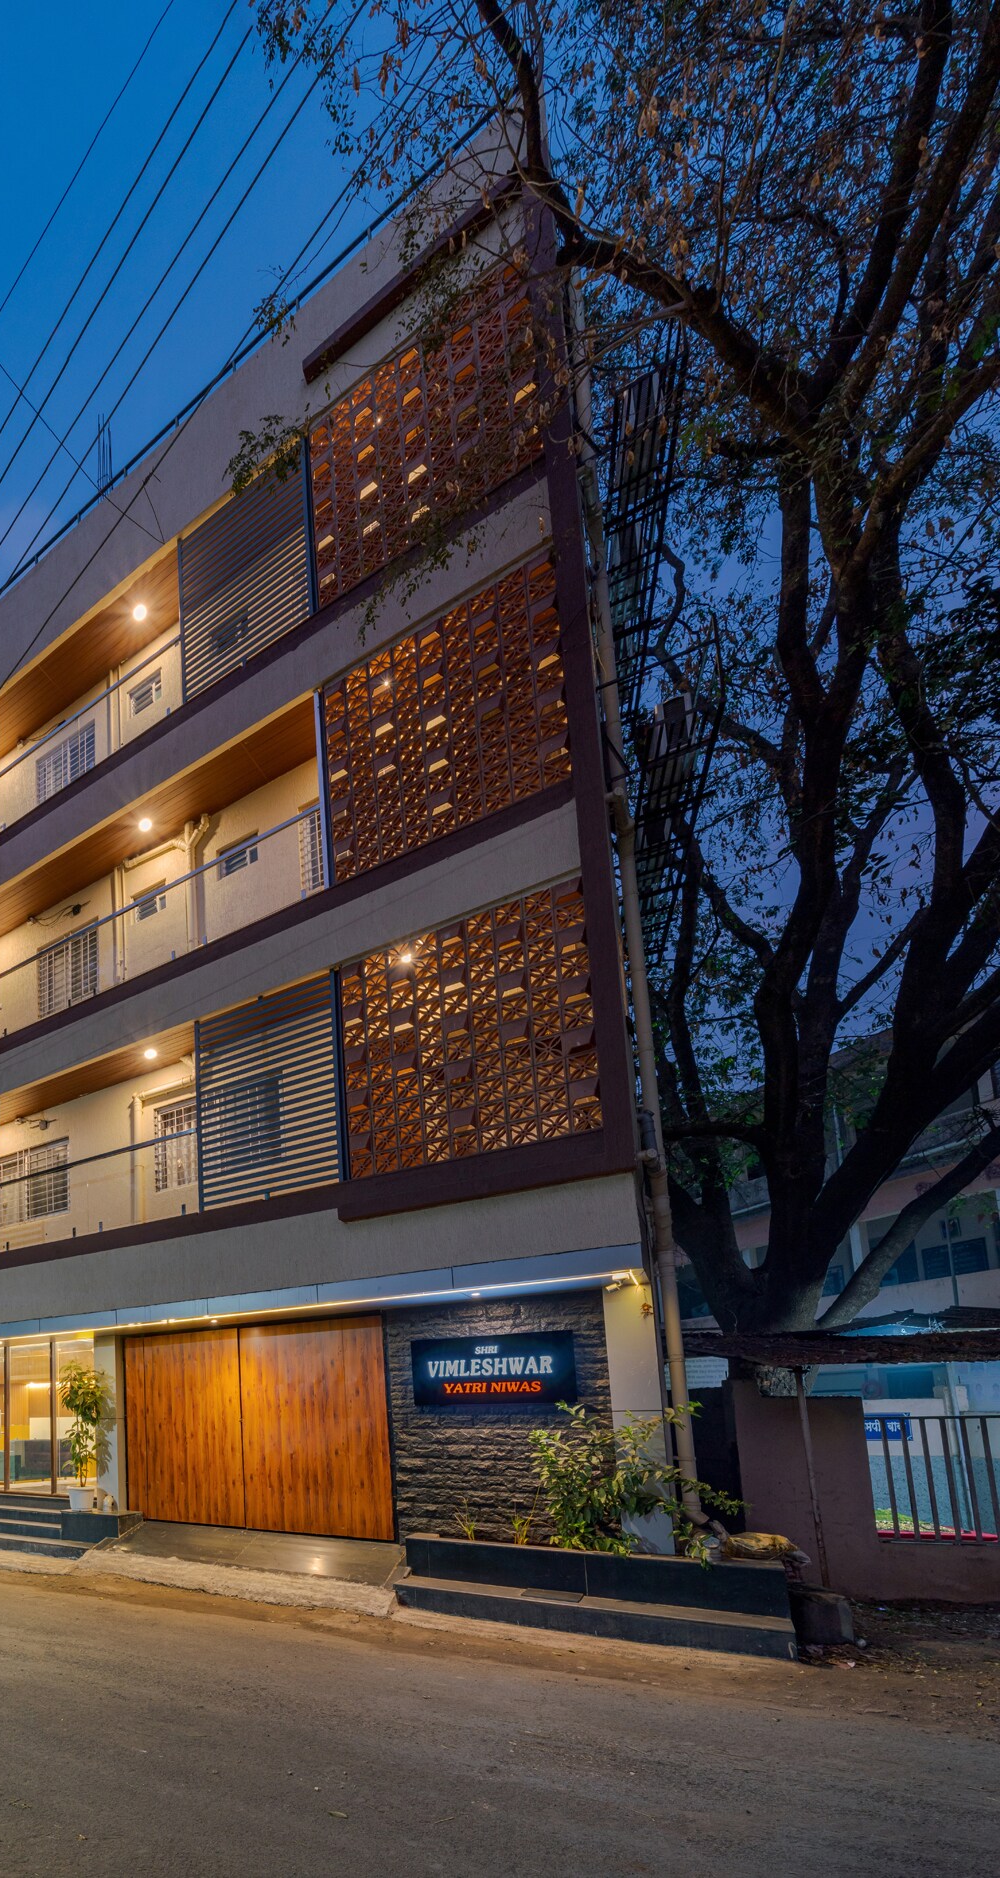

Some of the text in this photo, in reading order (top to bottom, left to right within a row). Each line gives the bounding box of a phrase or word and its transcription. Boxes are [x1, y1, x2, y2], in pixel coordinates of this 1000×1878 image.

[474, 1345, 498, 1355] SHRI
[427, 1355, 553, 1378] VIMLESHWAR
[444, 1381, 542, 1393] YATRI NIWAS
